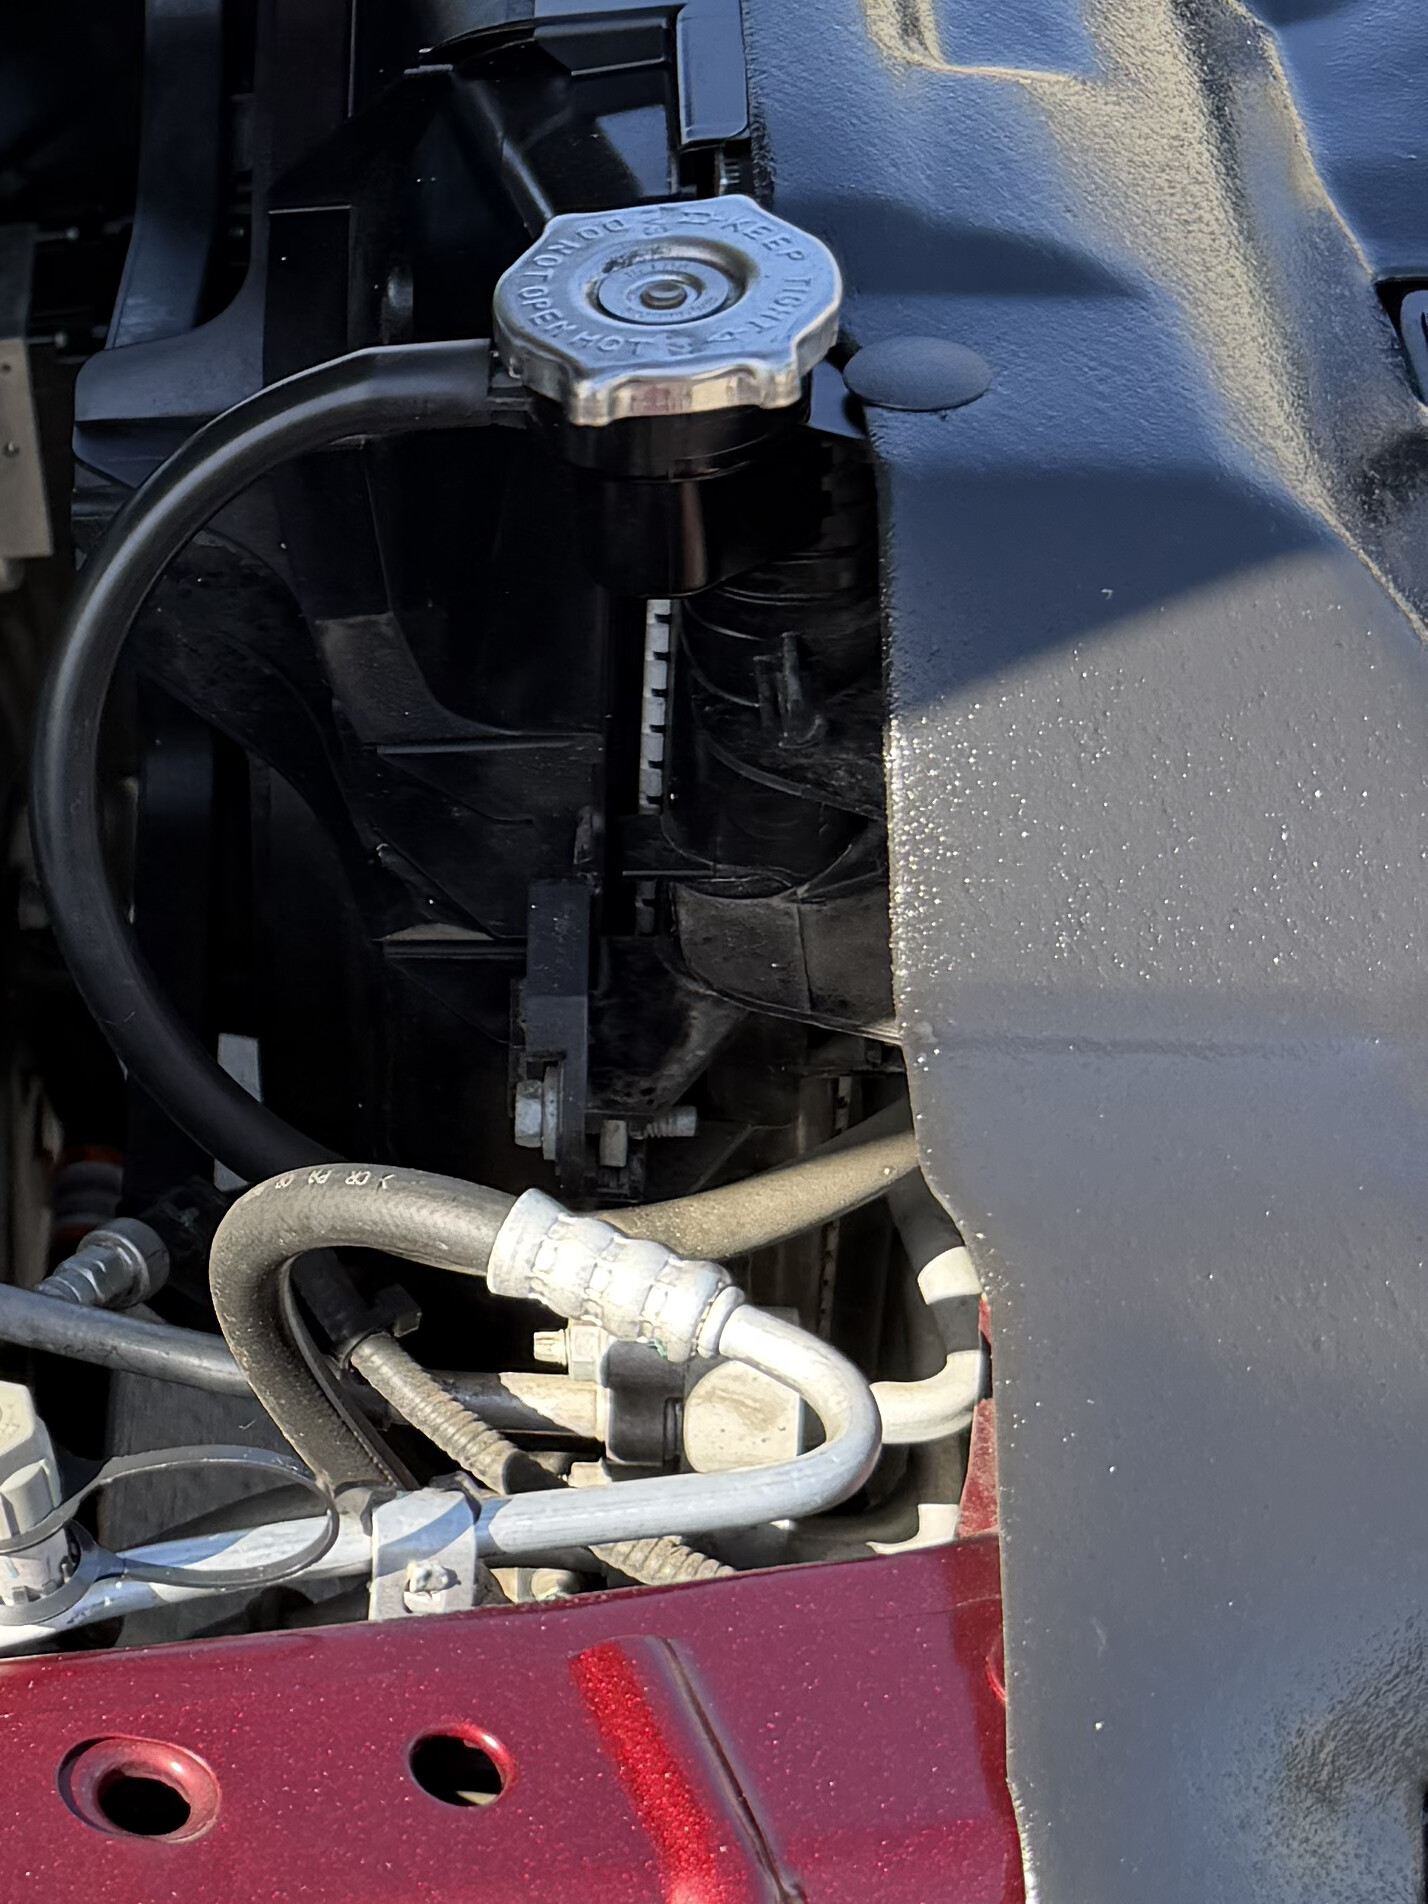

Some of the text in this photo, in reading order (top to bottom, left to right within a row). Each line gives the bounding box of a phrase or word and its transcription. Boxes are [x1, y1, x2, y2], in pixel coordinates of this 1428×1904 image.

[518, 217, 655, 356] DO NOT OPEN HOT
[719, 216, 813, 335] KEEP TIGHT
